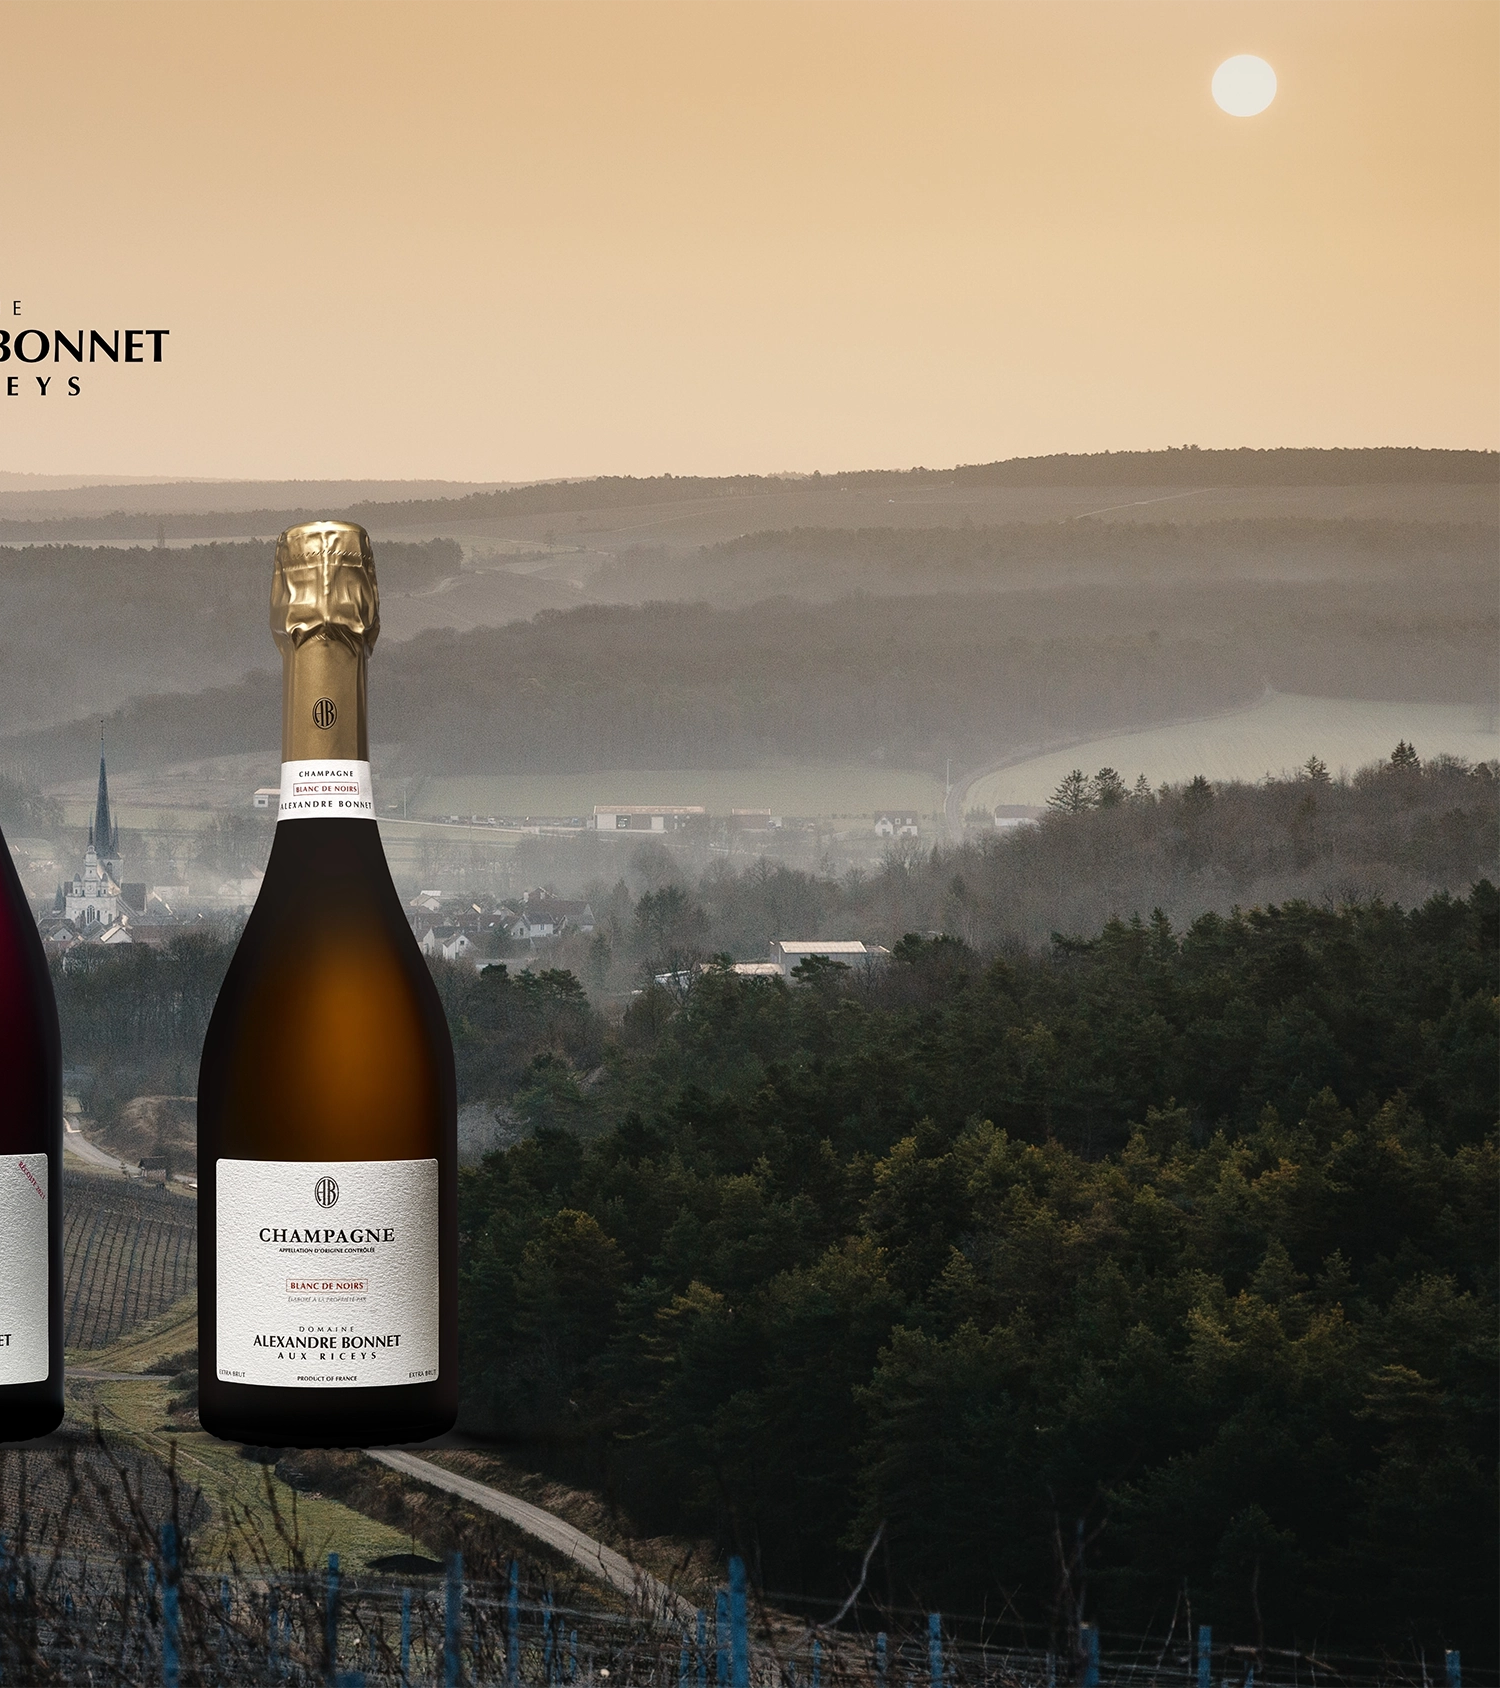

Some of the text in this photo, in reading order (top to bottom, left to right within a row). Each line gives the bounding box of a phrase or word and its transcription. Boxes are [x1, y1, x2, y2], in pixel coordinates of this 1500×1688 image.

[314, 699, 335, 727] AB
[280, 800, 372, 810] ALEXANDRE BONNET
[316, 1178, 337, 1207] AB
[259, 1228, 395, 1243] CHAMPAGNE
[336, 1282, 363, 1290] NOIRS
[254, 1334, 401, 1348] ALEXANDRE BONNET
[278, 1352, 377, 1360] AUX RICEYS
